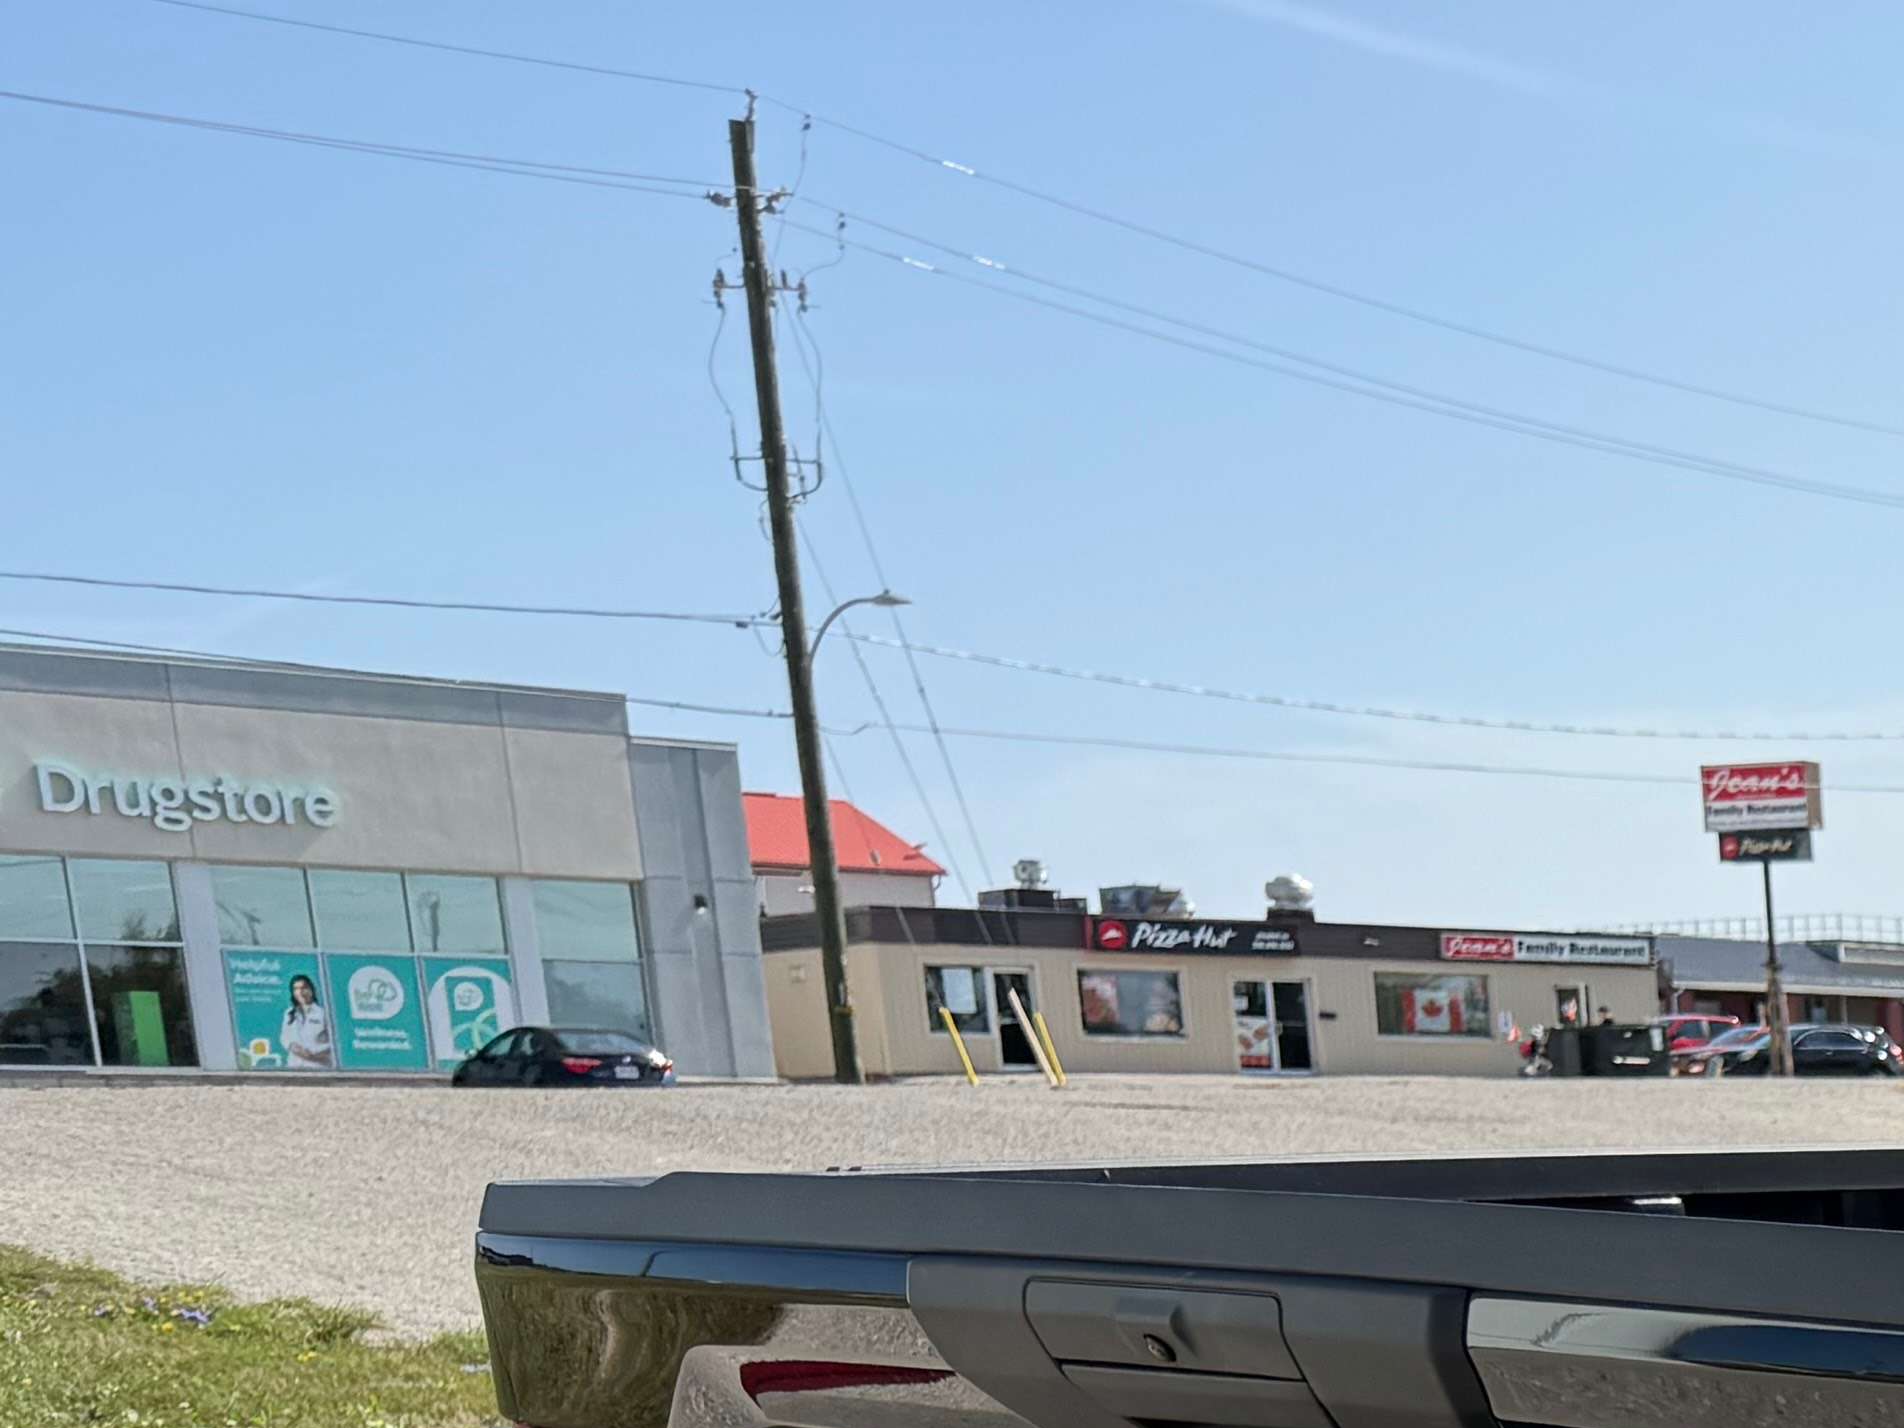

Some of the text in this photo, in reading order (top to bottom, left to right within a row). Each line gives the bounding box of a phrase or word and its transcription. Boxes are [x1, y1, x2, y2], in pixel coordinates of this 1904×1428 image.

[34, 761, 340, 832] Drugstore
[1707, 768, 1802, 800] Jean's
[1131, 921, 1239, 949] Pizza Hut
[1518, 940, 1565, 957] Family
[1569, 942, 1646, 958] Restaurant
